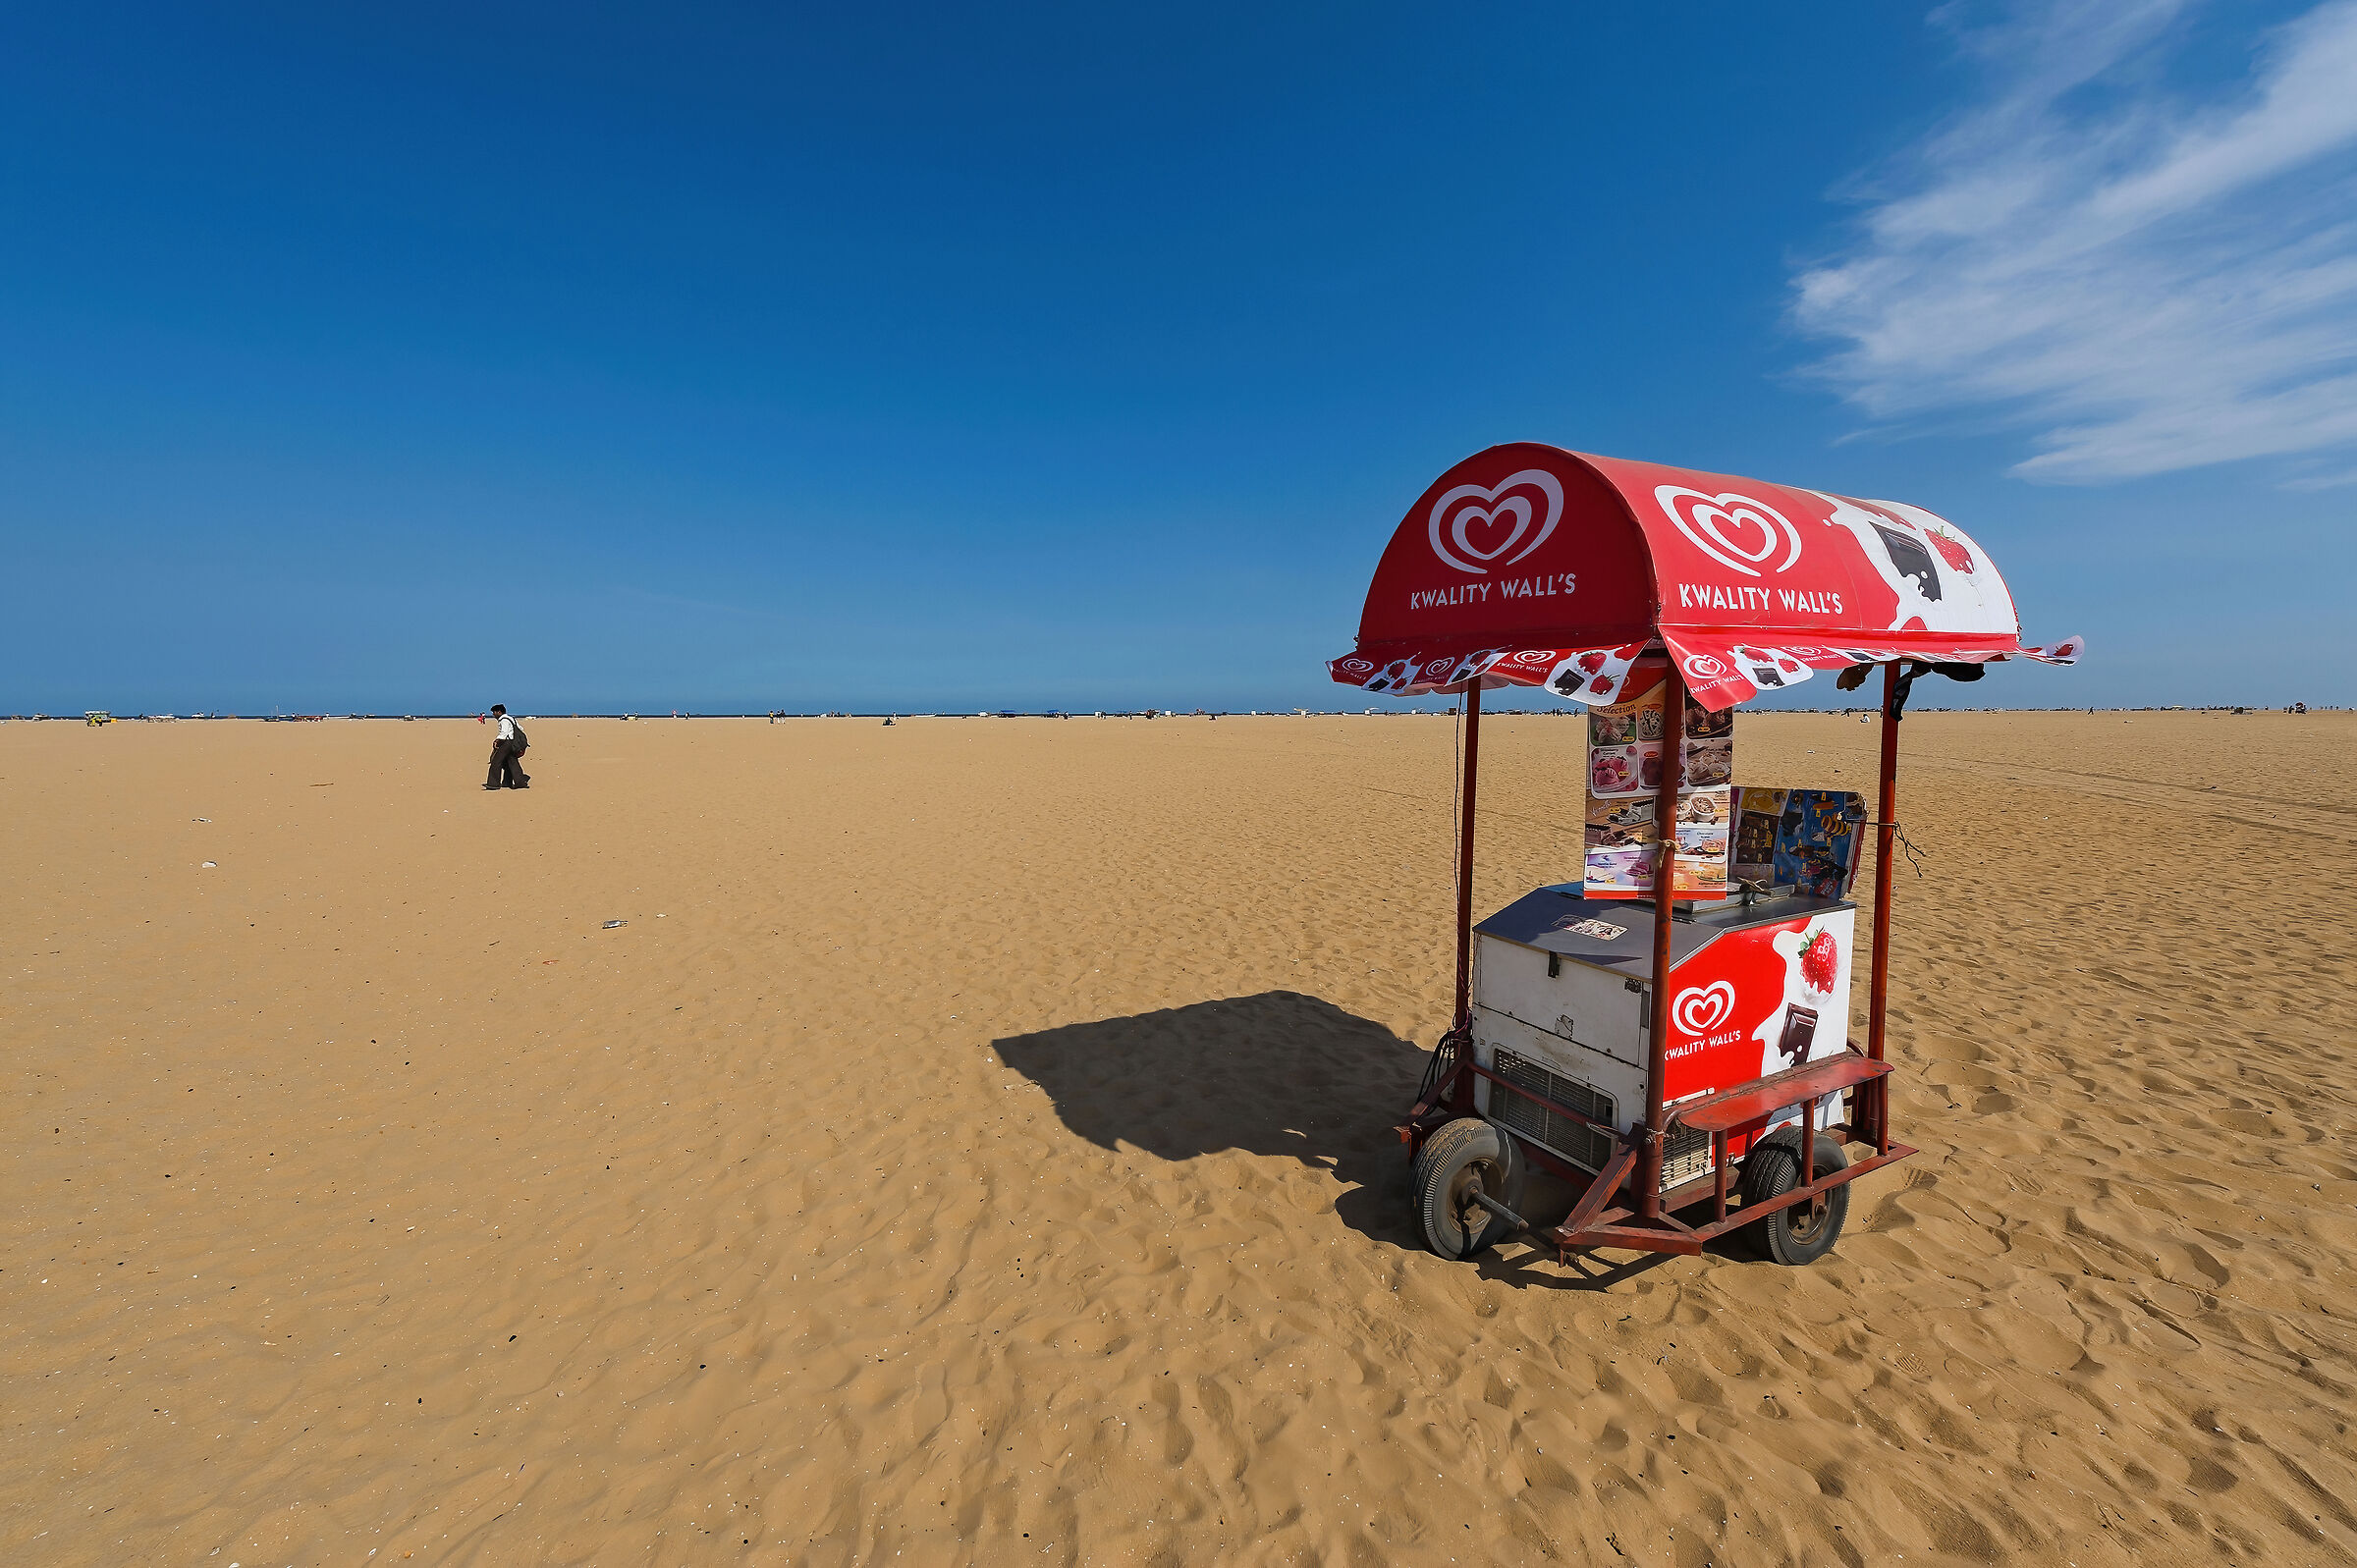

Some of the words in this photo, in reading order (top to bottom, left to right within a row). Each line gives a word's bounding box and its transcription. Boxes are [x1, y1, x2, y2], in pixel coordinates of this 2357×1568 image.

[1410, 581, 1492, 610] KWALITY
[1500, 572, 1577, 600] WALL'S
[1678, 583, 1771, 611] KWALITY
[1778, 588, 1843, 615] WALL'S
[1596, 703, 1636, 715] Selection
[1709, 1029, 1741, 1048] WALL'S
